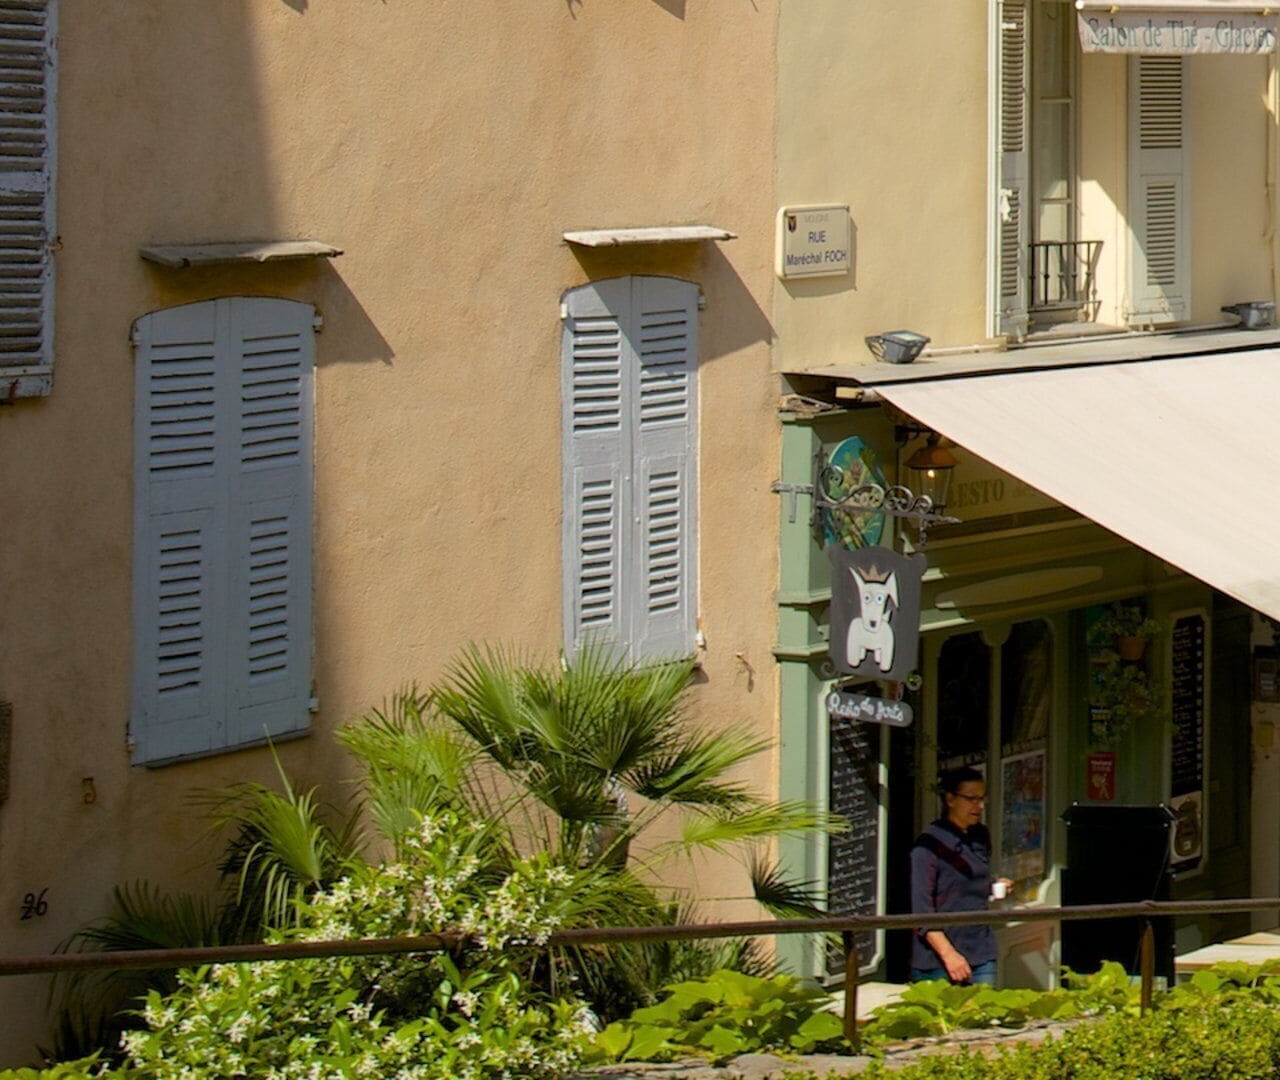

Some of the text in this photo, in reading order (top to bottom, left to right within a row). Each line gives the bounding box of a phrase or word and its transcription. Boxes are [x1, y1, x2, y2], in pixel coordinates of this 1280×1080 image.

[1088, 18, 1136, 47] Salon
[1143, 18, 1162, 47] de
[1167, 19, 1198, 47] Thé
[1216, 20, 1271, 48] Glacier
[808, 230, 826, 244] RUE
[786, 249, 848, 266] Maréchal FOCH
[948, 478, 1005, 508] ESTO
